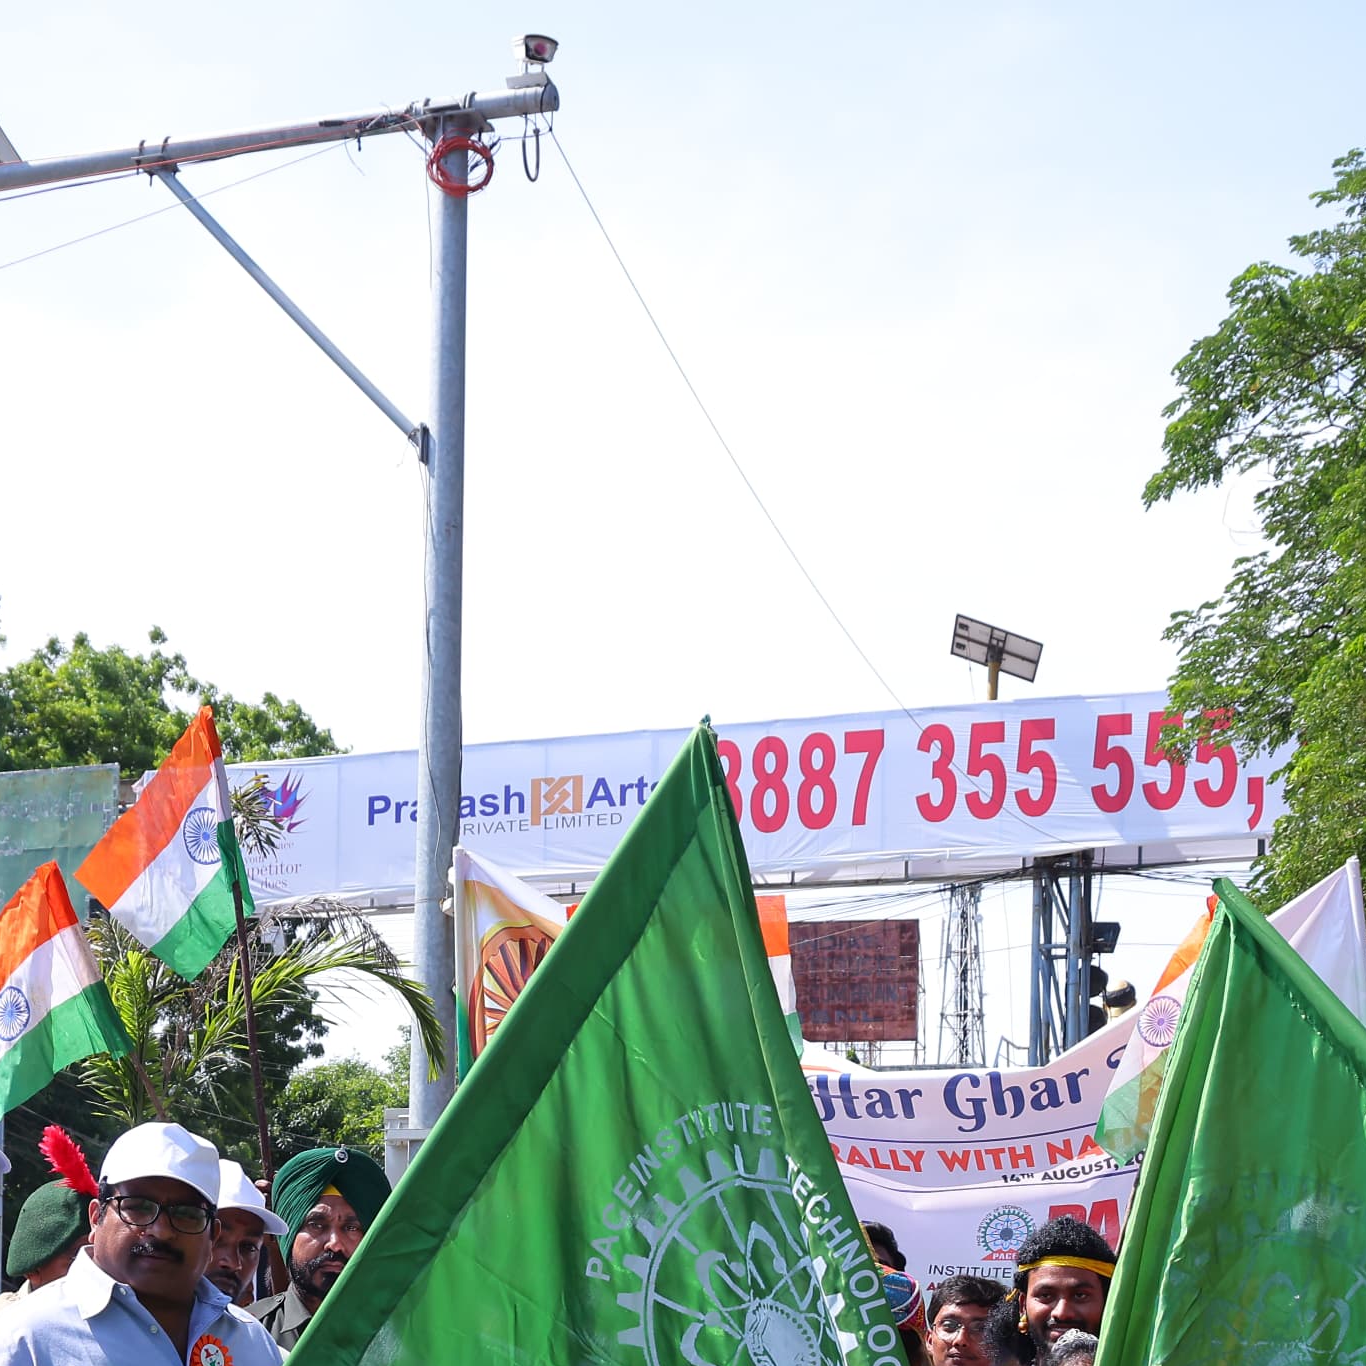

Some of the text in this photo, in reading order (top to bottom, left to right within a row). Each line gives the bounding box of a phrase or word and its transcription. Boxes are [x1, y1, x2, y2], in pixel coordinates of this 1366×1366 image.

[915, 718, 1058, 823] 355
[367, 785, 525, 827] Praash
[463, 812, 623, 835] RIVATE LIMITED
[943, 1066, 1089, 1132] Ghar
[937, 1144, 1034, 1172] WITH
[1041, 1157, 1120, 1181] AUGUST,
[928, 1264, 1012, 1279] INSTITUTE
